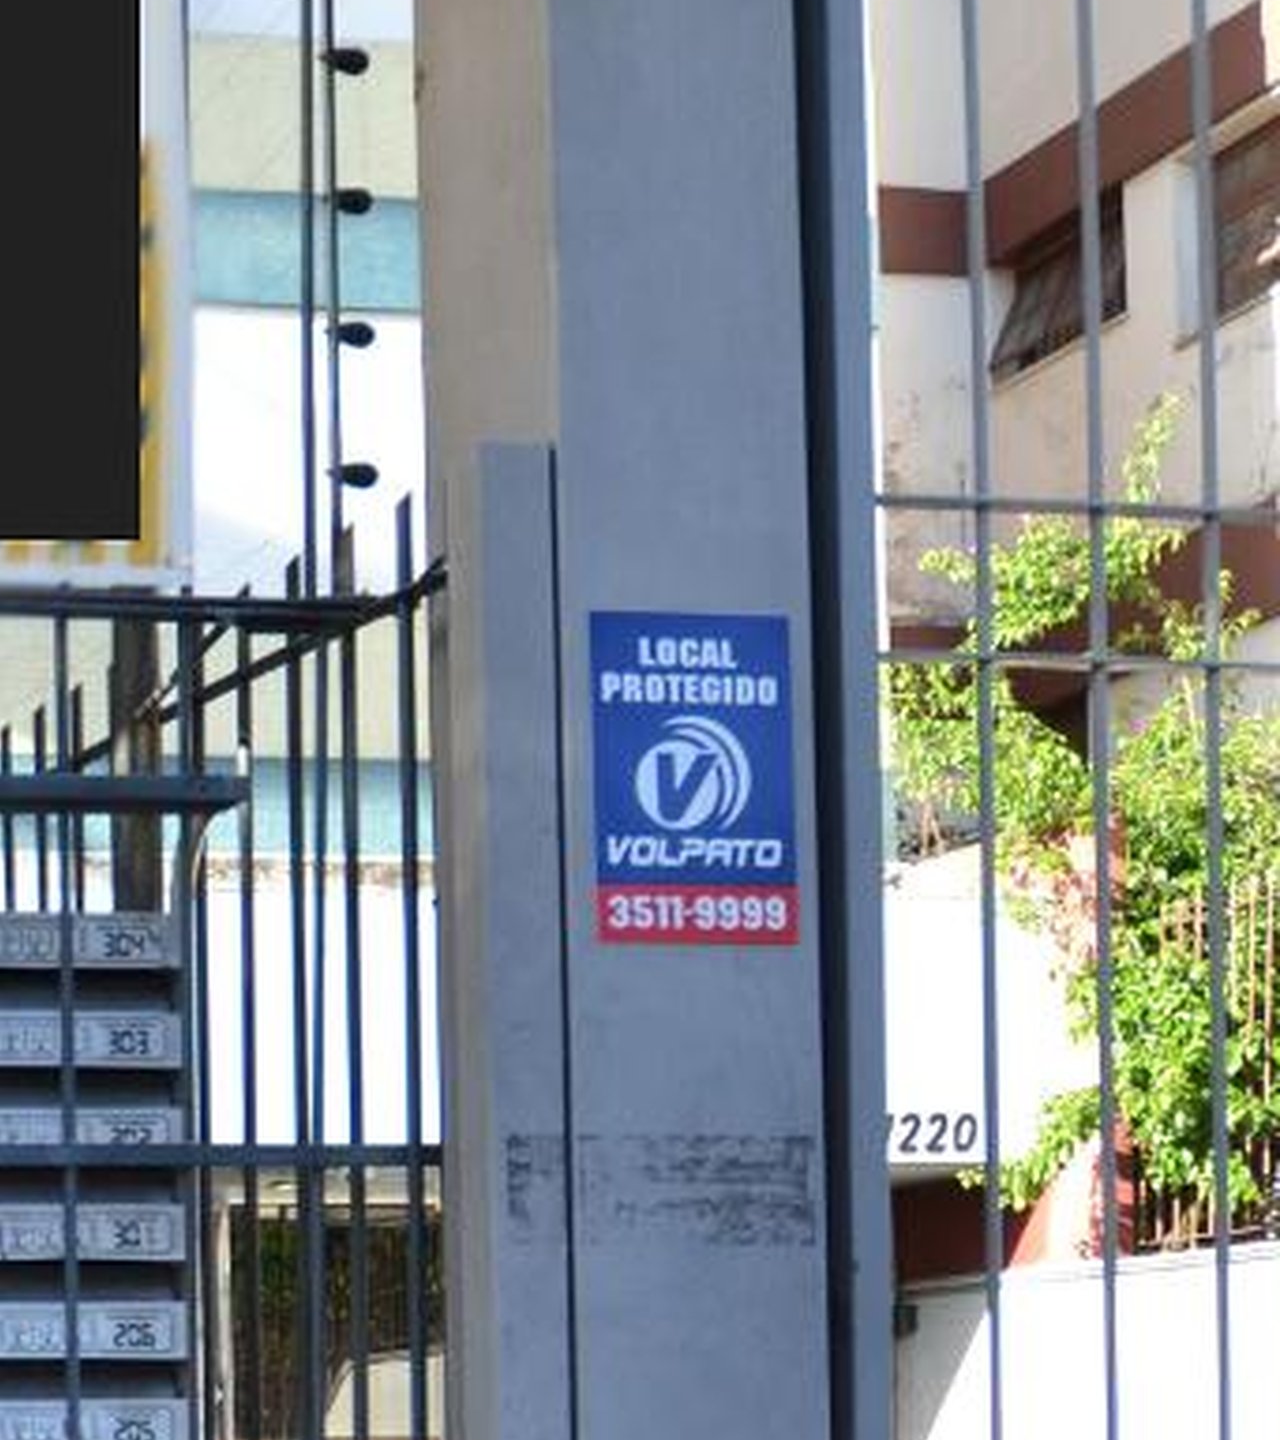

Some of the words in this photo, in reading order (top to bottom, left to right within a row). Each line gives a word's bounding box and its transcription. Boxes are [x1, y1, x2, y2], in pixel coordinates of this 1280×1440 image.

[639, 636, 738, 670] LOCAL
[601, 674, 778, 706] PROTEGIDO
[607, 837, 783, 868] VOLPATO
[608, 894, 787, 931] 3511-9999
